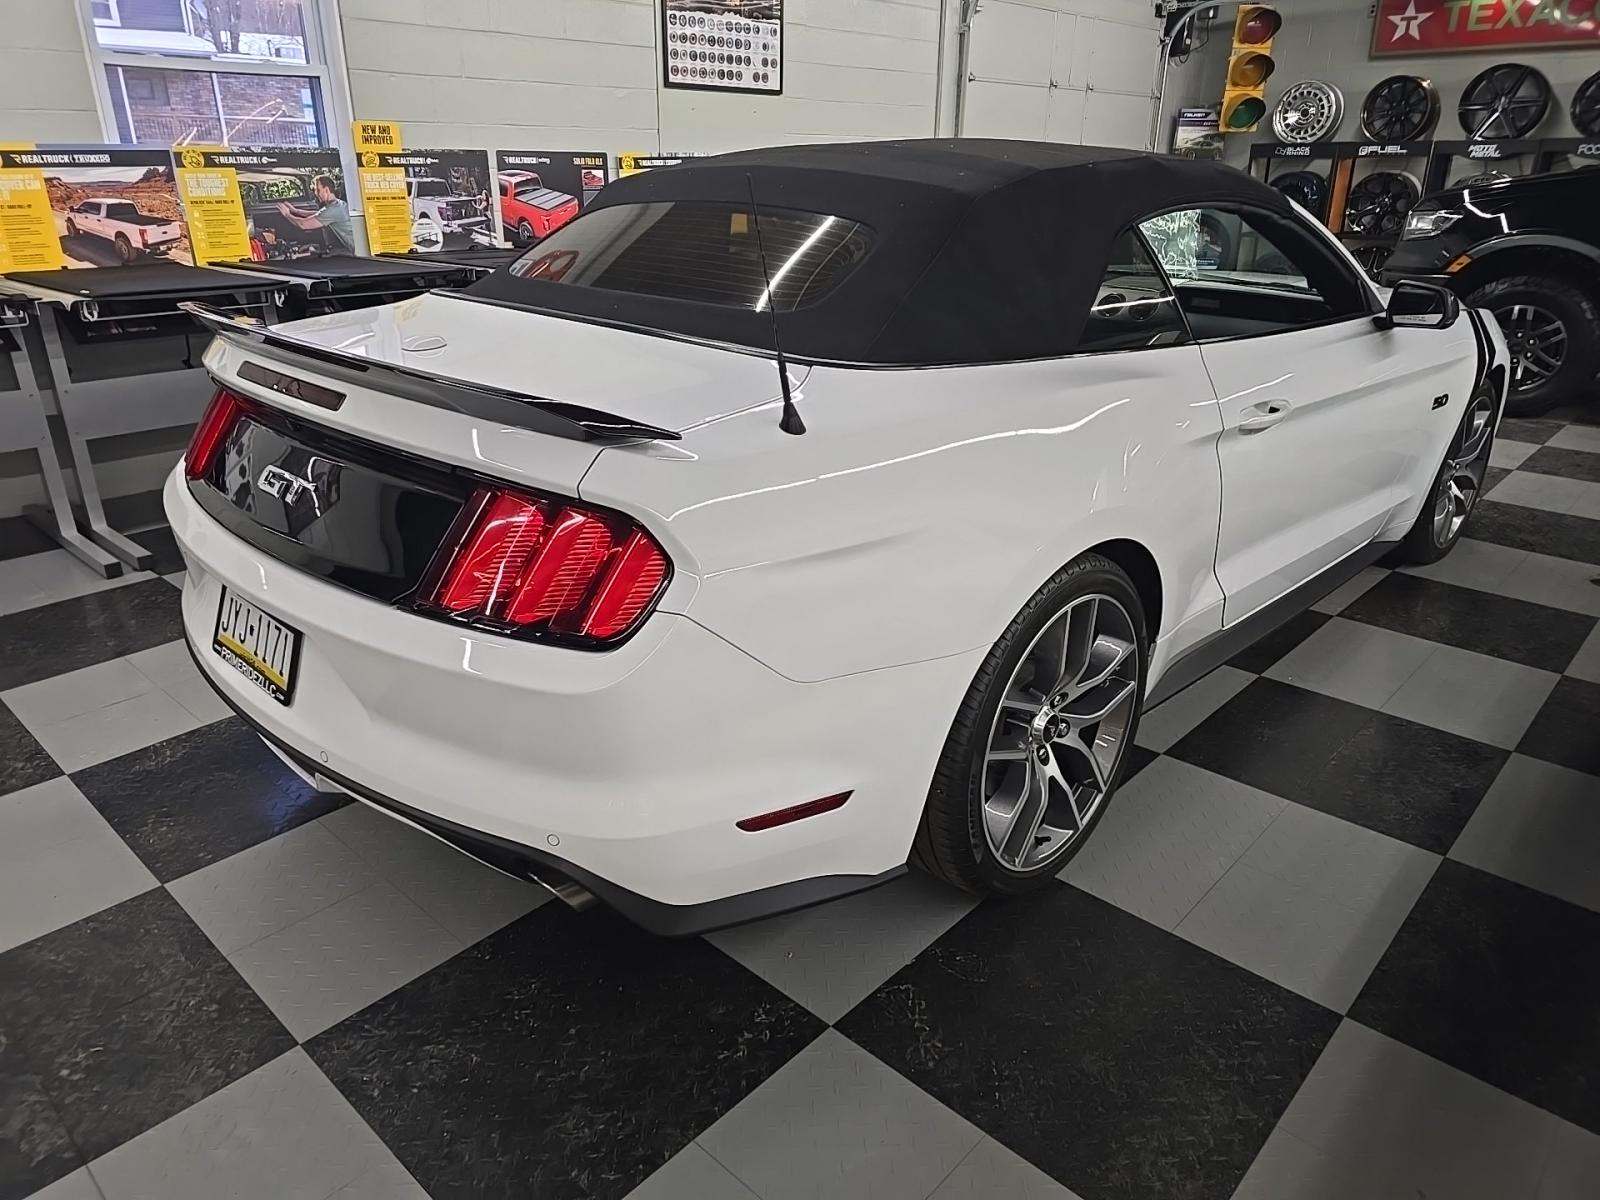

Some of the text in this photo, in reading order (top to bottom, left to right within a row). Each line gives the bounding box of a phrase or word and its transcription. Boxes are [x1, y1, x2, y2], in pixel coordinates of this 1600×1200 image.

[1443, 0, 1600, 33] TEXAC
[361, 124, 391, 135] NEW AND
[361, 134, 394, 145] IMPROVED
[1366, 145, 1407, 155] FUEL
[1469, 150, 1502, 158] METAL
[20, 154, 70, 164] REALTRUCK
[220, 155, 258, 164] REALTRUCK
[393, 156, 424, 164] REALTRUCK
[257, 464, 315, 506] GT
